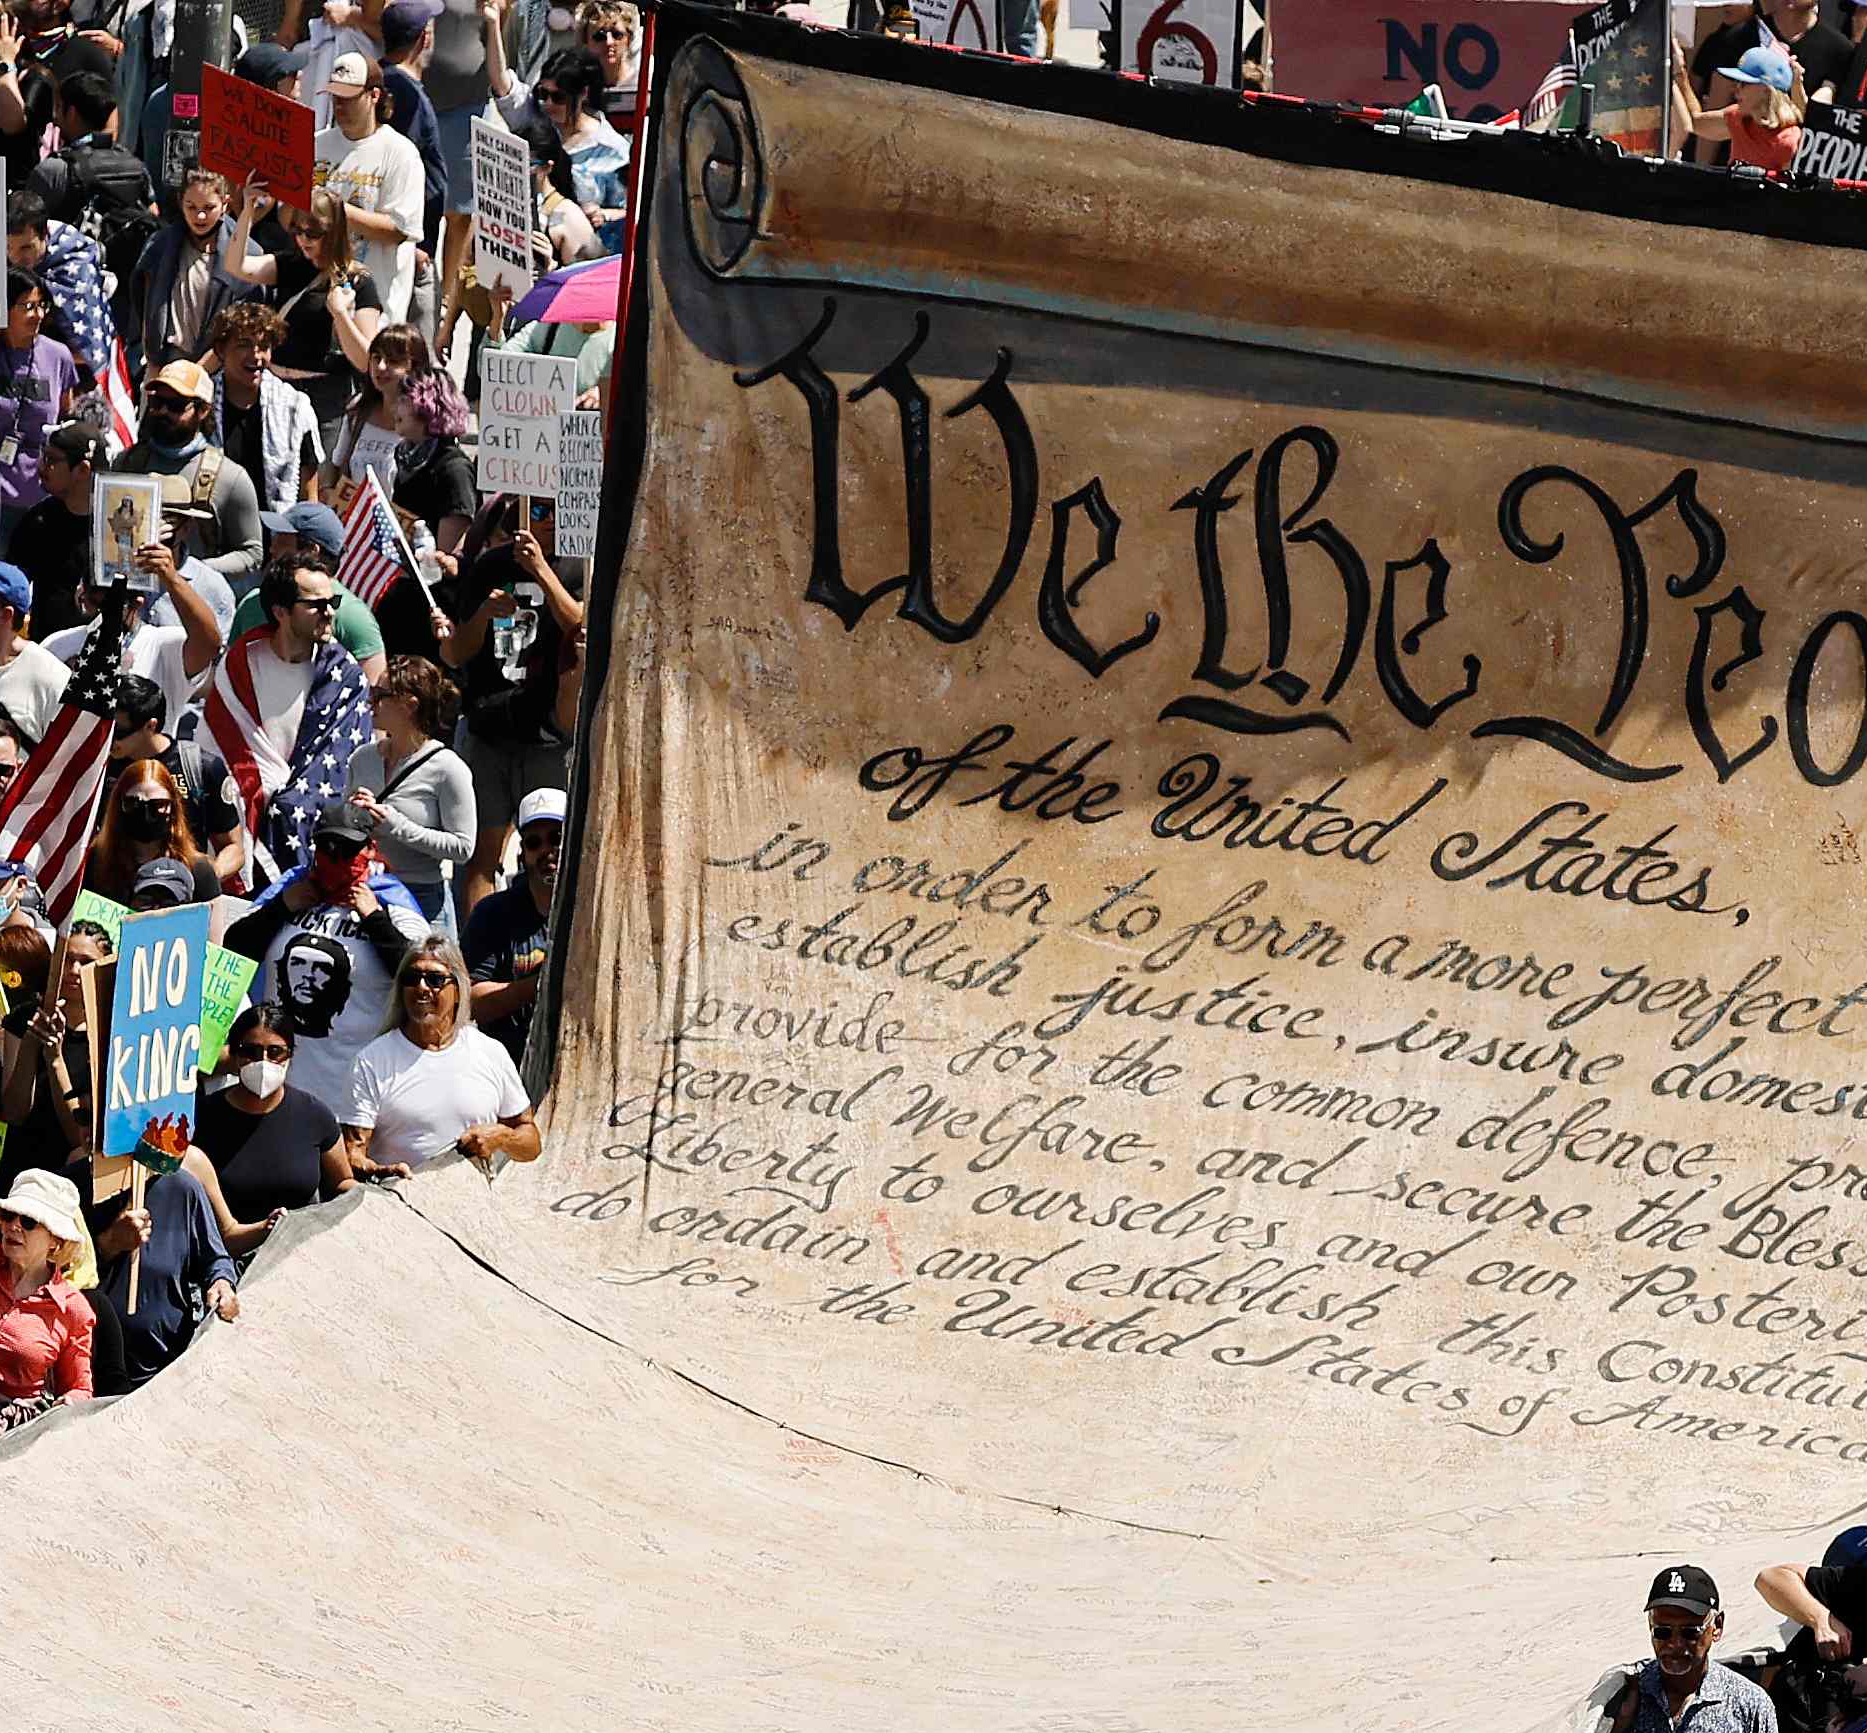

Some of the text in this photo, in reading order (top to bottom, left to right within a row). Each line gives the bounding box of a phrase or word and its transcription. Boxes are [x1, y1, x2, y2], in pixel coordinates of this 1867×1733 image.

[1382, 17, 1502, 94] NO
[478, 217, 527, 248] LOSE
[478, 233, 528, 271] THEM
[485, 356, 536, 387] ELECT
[489, 384, 558, 418] CLOWN
[732, 295, 1161, 678] We
[1156, 422, 1484, 740] the
[859, 722, 1751, 928] of the United States,
[130, 939, 190, 1019] NO
